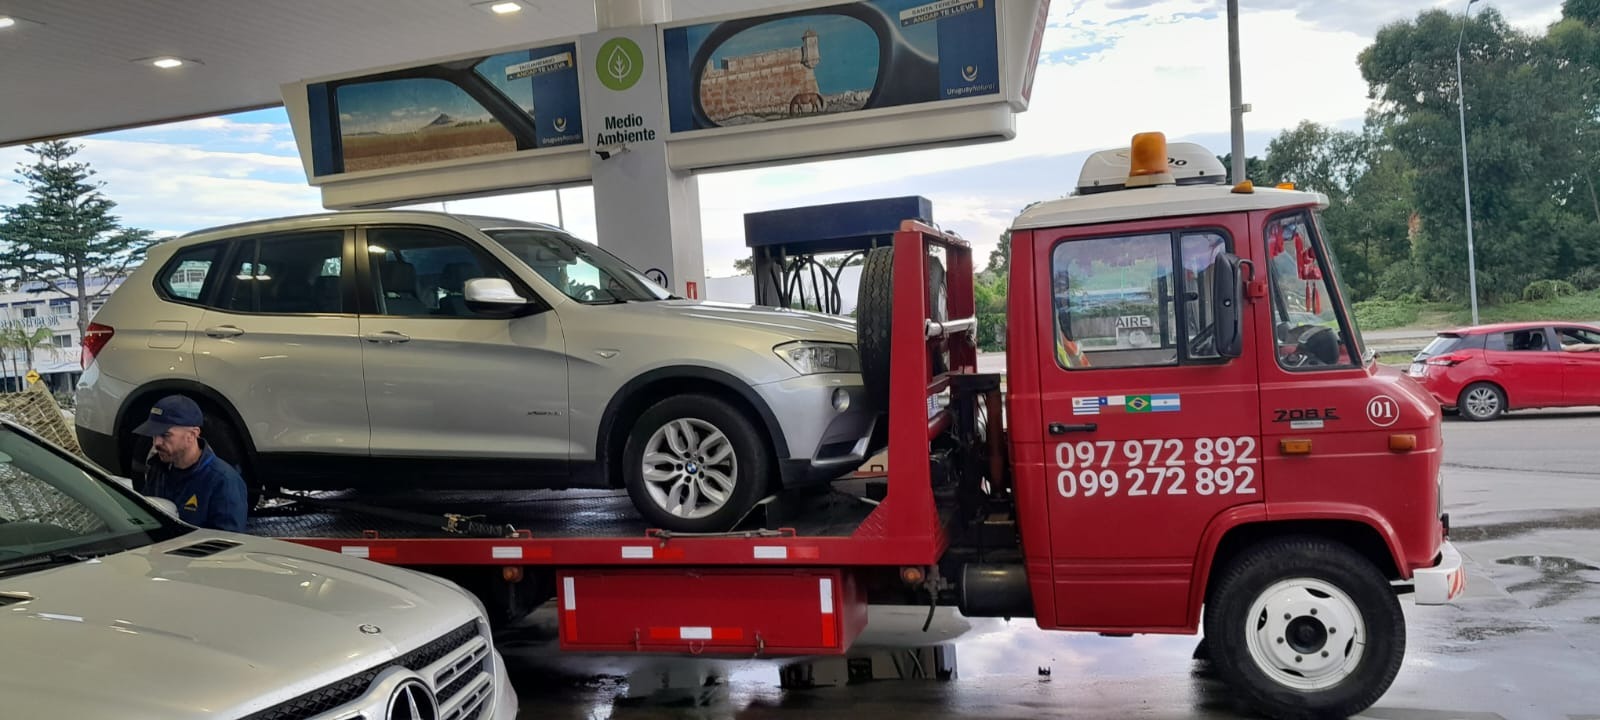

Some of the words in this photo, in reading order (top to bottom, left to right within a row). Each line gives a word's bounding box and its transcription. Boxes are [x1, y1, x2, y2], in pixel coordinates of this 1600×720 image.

[951, 2, 975, 14] LLEVA
[605, 113, 643, 130] Medio
[597, 127, 656, 147] Ambiente
[1115, 316, 1149, 328] AIRE
[1370, 401, 1393, 418] 01
[1055, 440, 1116, 469] 097
[1123, 438, 1186, 467] 972
[1194, 436, 1257, 465] 892
[1057, 469, 1119, 497] 099
[1125, 466, 1188, 496] 272
[1195, 466, 1256, 495] 892
